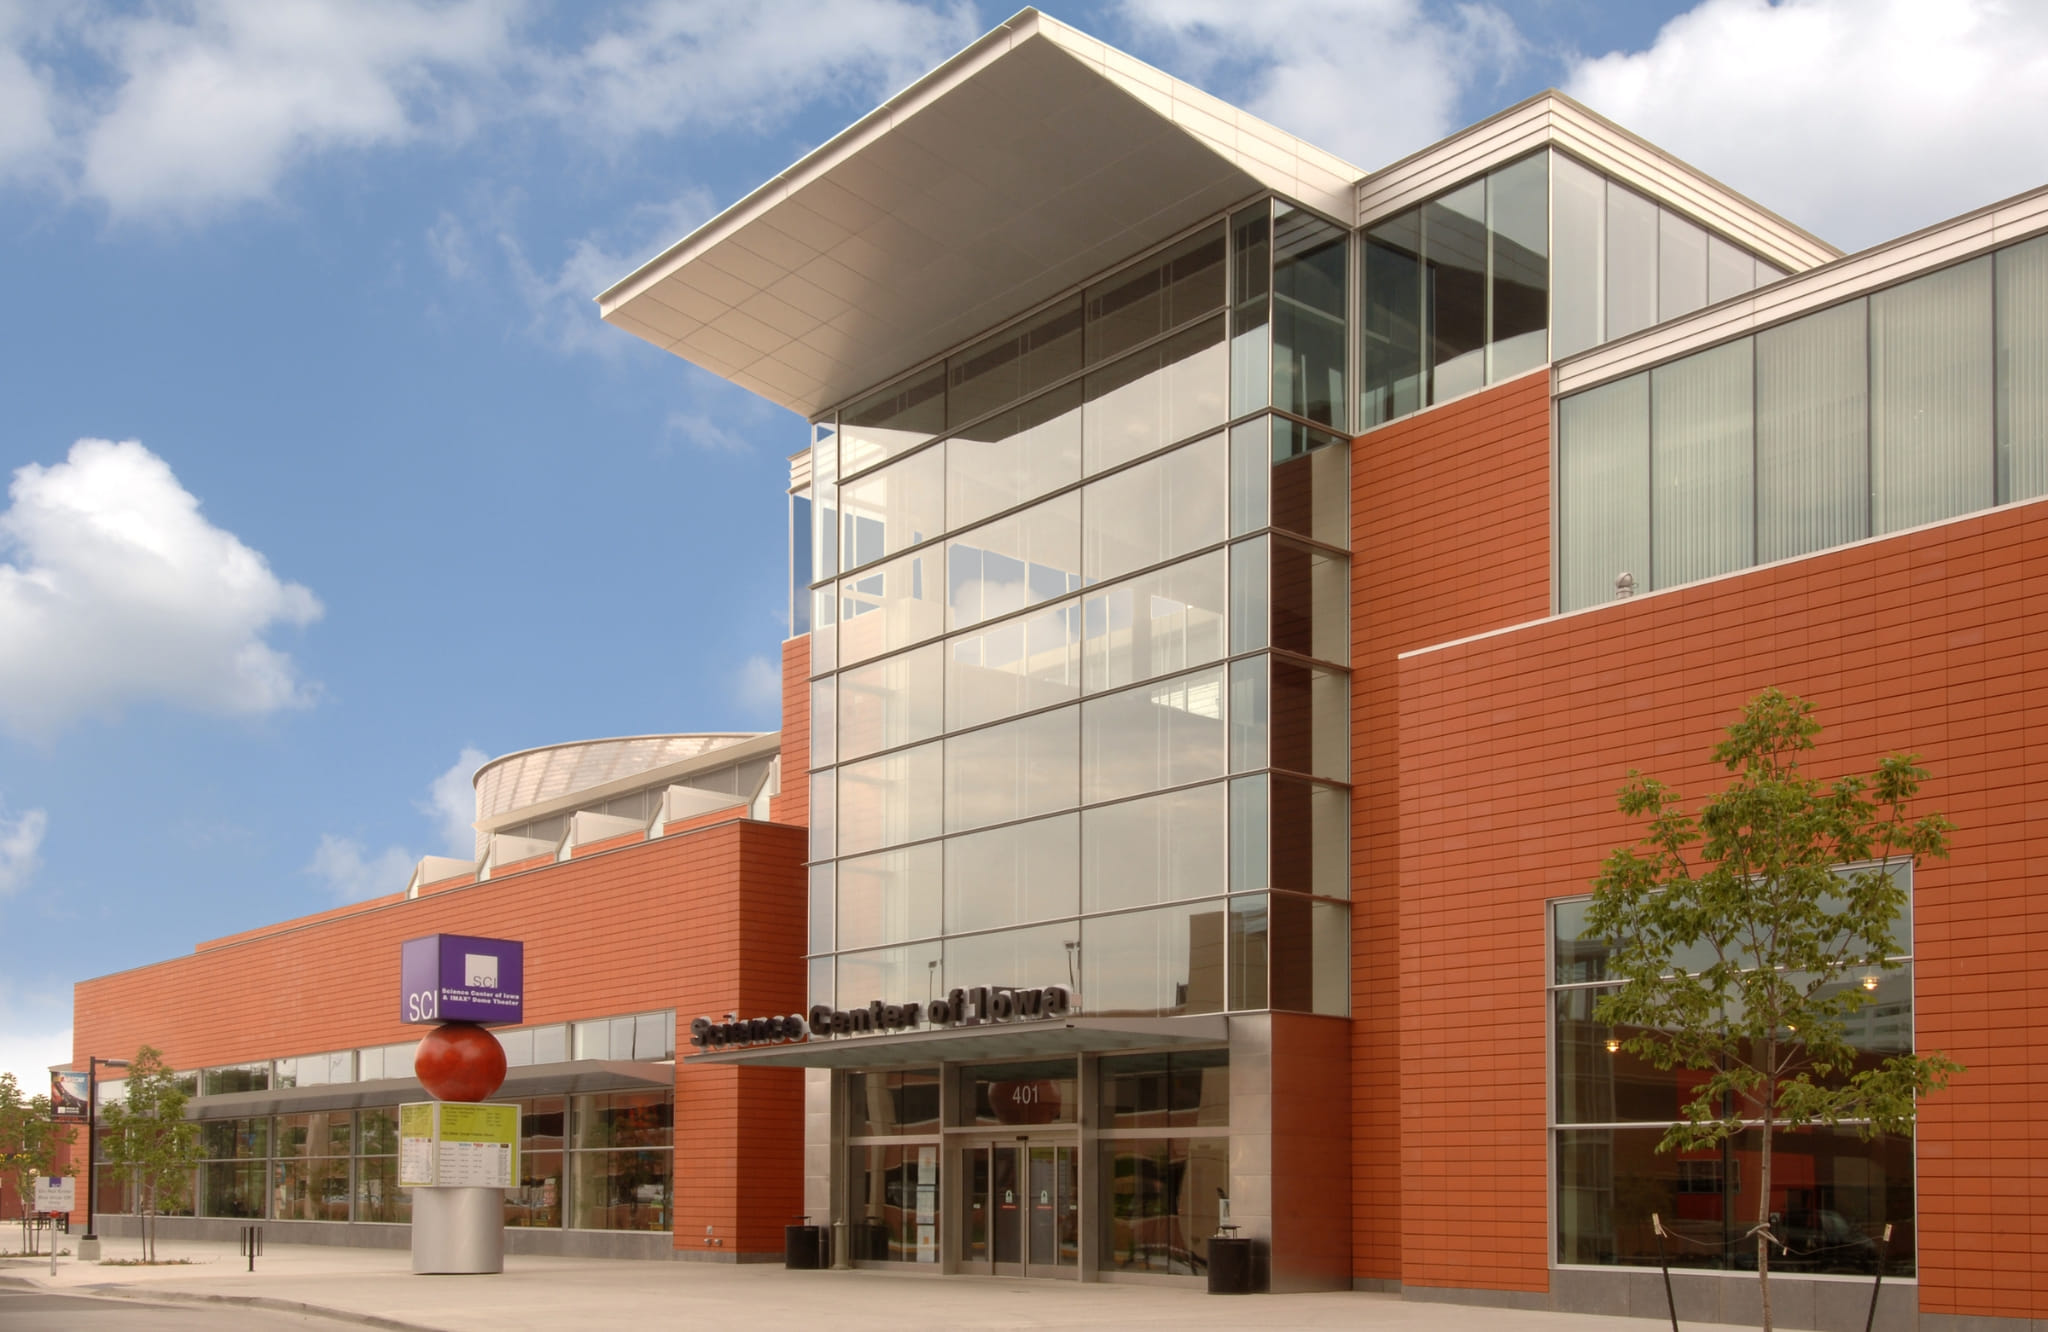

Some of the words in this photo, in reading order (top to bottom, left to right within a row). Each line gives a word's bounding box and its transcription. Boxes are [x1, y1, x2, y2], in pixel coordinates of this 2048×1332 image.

[473, 976, 497, 988] SCI
[409, 990, 438, 1021] SCI
[493, 998, 519, 1006] Theater
[690, 1016, 805, 1047] Science
[809, 1000, 922, 1037] Center
[928, 988, 966, 1025] of
[972, 985, 1070, 1020] Iowa
[1012, 1085, 1039, 1105] 401
